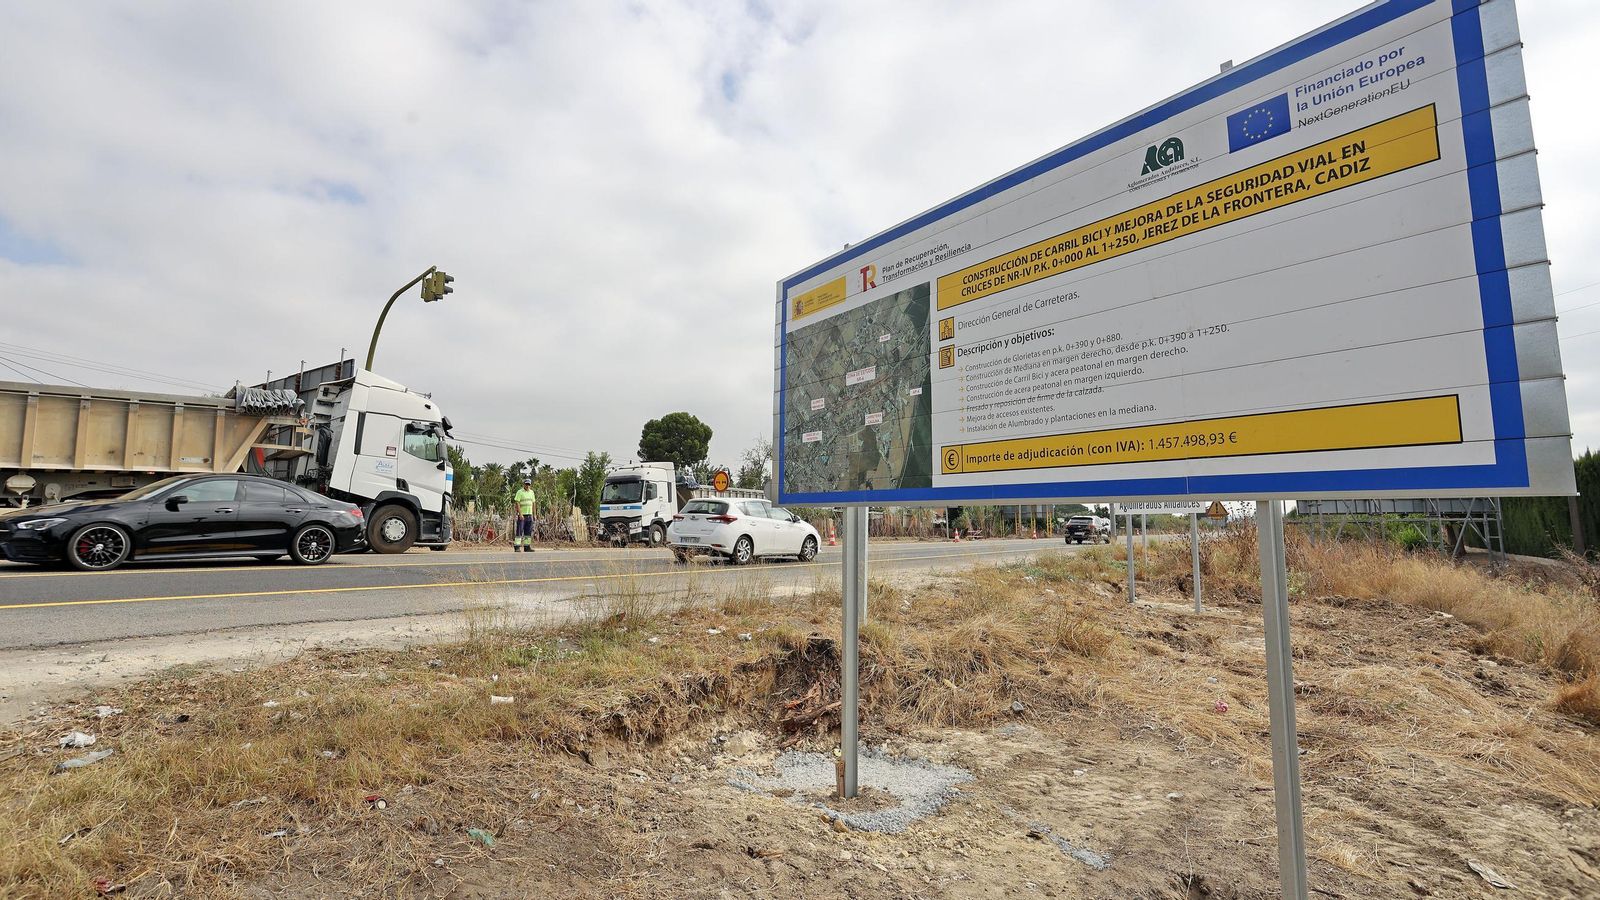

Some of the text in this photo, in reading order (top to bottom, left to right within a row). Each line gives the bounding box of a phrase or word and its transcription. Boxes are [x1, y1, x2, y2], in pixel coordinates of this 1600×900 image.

[1295, 46, 1405, 97] Financiado por
[1296, 56, 1425, 112] la Unión Europea
[1298, 78, 1410, 128] NextGenerationEU
[1127, 174, 1160, 188] Aglomerados
[1160, 162, 1189, 176] Andaluces,
[961, 157, 1372, 297] CRUCES DE NR-IV P.K. 0+000 AL 1+250, JEREZ DE LA FRONTERA, CADIZ
[962, 140, 1367, 285] CONSTRUCCIÓN DE CARRIL BICI Y MEJORA DE LA SEGURIDAD VIAL EN
[882, 242, 950, 274] Plan de Recuperación,
[882, 242, 972, 283] Transformación y Resiliencia
[958, 290, 1080, 330] Dirección General de Carreteras.
[958, 328, 1055, 357] Descripción y objetivos:
[965, 358, 1002, 372] Construcción
[1003, 356, 1011, 364] de
[1012, 350, 1040, 362] Glorietas
[1052, 345, 1064, 356] p.k.
[1065, 339, 1089, 351] 0+390
[1096, 333, 1123, 345] 0+880.
[966, 368, 1003, 382] Construcción
[1004, 367, 1012, 375] de
[1013, 362, 1040, 373] Mediana
[1052, 355, 1079, 366] margen
[1081, 348, 1114, 360] derecho,
[1115, 342, 1140, 353] desde
[1141, 338, 1157, 350] p.k.
[1158, 332, 1186, 345] 0+390
[1196, 323, 1230, 336] 1+250.
[966, 378, 1003, 392] Construcción
[1004, 377, 1012, 385] de
[1013, 373, 1031, 384] Carril
[1032, 371, 1043, 380] Bici
[1050, 368, 1069, 377] acera
[1070, 360, 1103, 375] peatonal
[1116, 354, 1148, 366] margen
[1150, 346, 1188, 360] derecho.
[966, 388, 1003, 402] Construcción
[1004, 388, 1012, 396] de
[1014, 386, 1031, 394] acera
[1032, 378, 1061, 392] peatonal
[1074, 373, 1102, 385] margen
[1104, 367, 1145, 380] izquierdo.
[966, 401, 988, 412] Fresado
[994, 397, 1026, 410] reposición
[1056, 390, 1065, 398] de
[1066, 389, 1072, 397] la
[1074, 385, 1104, 396] calzada.
[966, 412, 986, 423] Mejora
[996, 409, 1020, 418] accesos
[1020, 405, 1055, 416] existentes.
[966, 422, 998, 433] Instalación
[1008, 417, 1043, 428] Alumbrado
[1050, 411, 1096, 424] plantaciones
[1109, 407, 1116, 415] la
[1118, 403, 1156, 415] mediana.
[948, 453, 955, 466] €
[966, 431, 1237, 464] Importe de adjudicación (con IVA): 1.457.498,93 €
